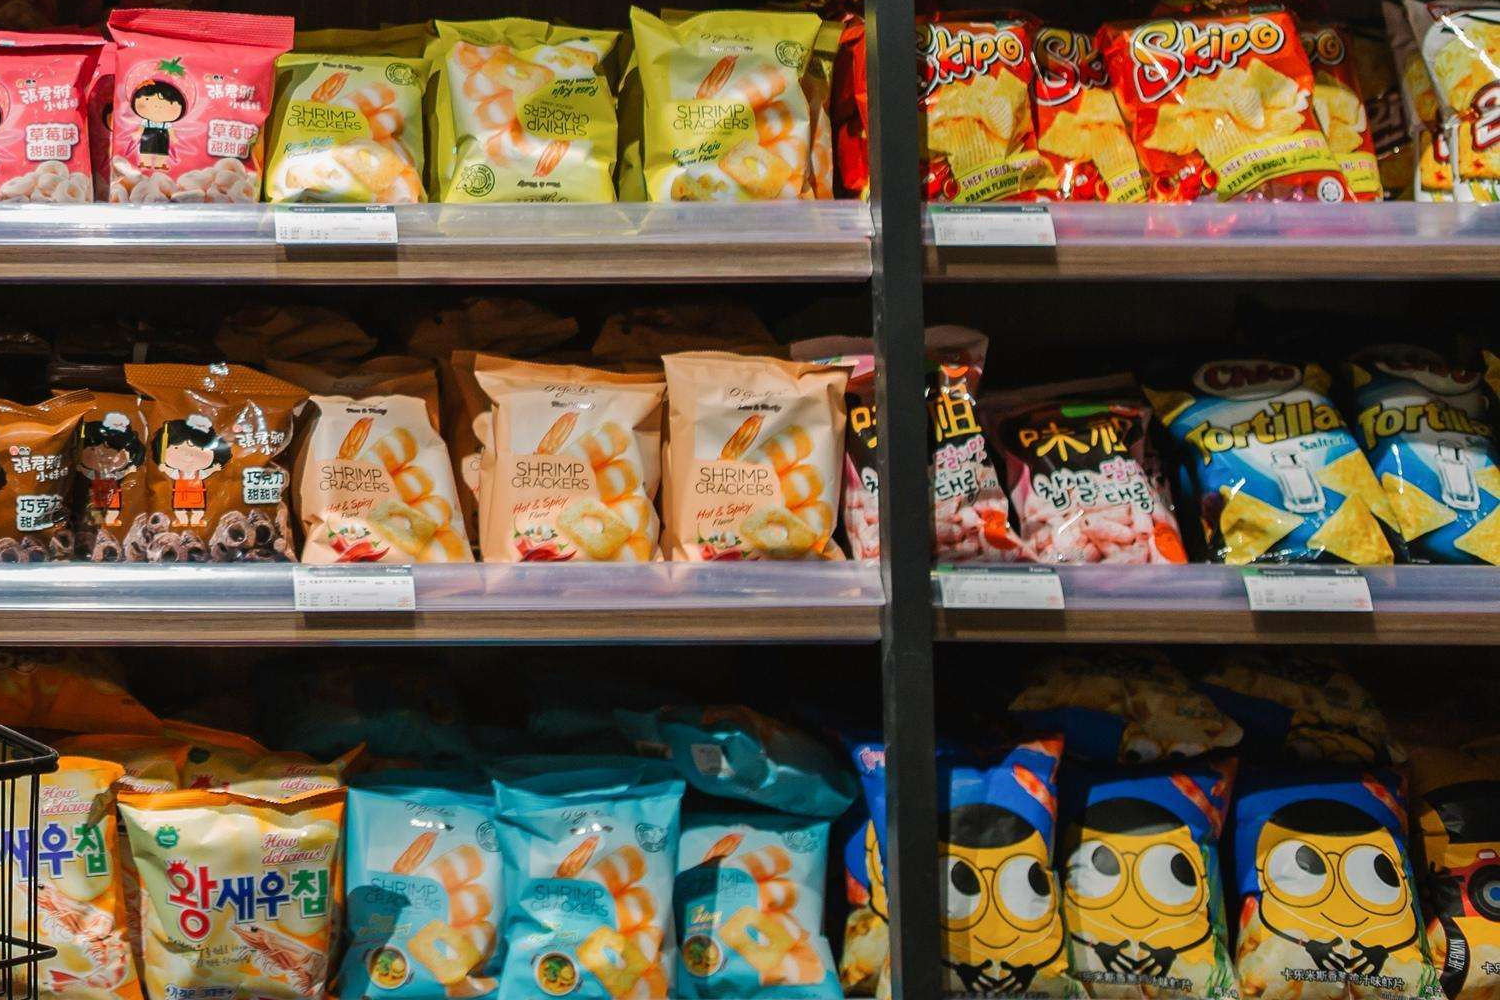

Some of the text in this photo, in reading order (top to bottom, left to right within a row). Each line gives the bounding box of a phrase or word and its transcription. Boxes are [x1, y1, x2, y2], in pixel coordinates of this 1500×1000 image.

[1131, 17, 1285, 104] Skipo
[291, 104, 356, 121] SHRIMP
[524, 103, 590, 125] CRACKERS
[676, 104, 745, 120] SHRIMP
[287, 116, 362, 132] CRACKERS
[526, 118, 588, 137] SHRIMP
[672, 117, 749, 132] CRACKERS
[29, 126, 79, 143] 草莓味
[29, 143, 70, 159] 甜甜圈
[1186, 400, 1346, 464] Tortilla
[1358, 401, 1491, 450] Tortilla
[245, 468, 287, 486] 巧克力
[321, 465, 382, 483] SHRIMP
[515, 462, 585, 478] SHRIMP
[699, 467, 768, 483] SHRIMP
[319, 478, 390, 493] CRACKERS
[511, 475, 590, 491] CRACKERS
[695, 481, 774, 497] CRACKERS
[245, 487, 284, 502] 甜甜圈
[513, 500, 531, 513] Hot
[542, 495, 570, 511] Spicy
[697, 507, 714, 521] Hot
[725, 502, 755, 518] Spicy
[262, 833, 297, 850] How
[261, 844, 331, 865] delicious!
[369, 878, 438, 901] SHRIMP
[534, 883, 604, 903] SHRIMP
[166, 858, 329, 941] 왕새우칩
[530, 896, 608, 917] CRACKERS
[1447, 937, 1467, 973] HERMAN
